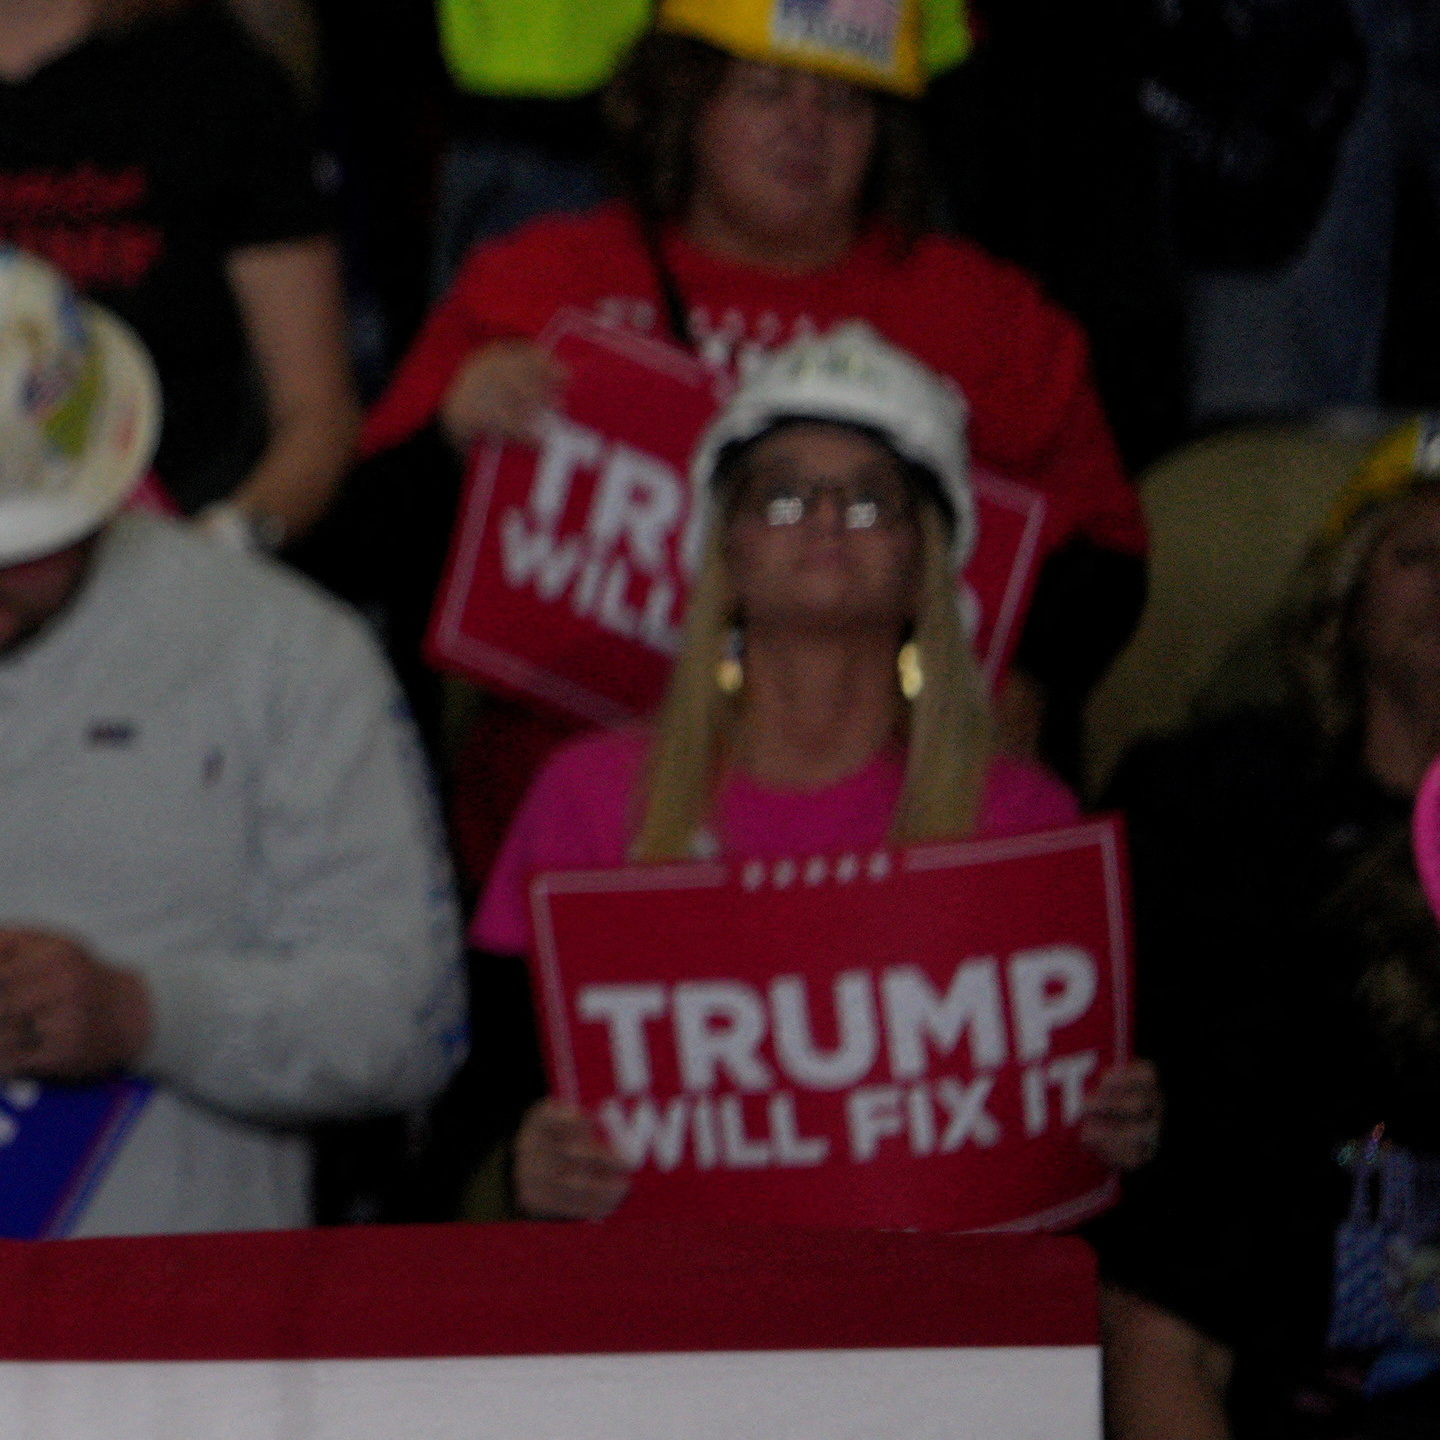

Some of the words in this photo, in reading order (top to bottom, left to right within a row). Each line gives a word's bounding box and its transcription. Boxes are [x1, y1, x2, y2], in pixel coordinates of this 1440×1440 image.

[574, 943, 1099, 1092] TRUMP
[594, 1086, 830, 1173] WILL
[846, 1074, 1004, 1165] FIX
[1020, 1048, 1100, 1138] IT
